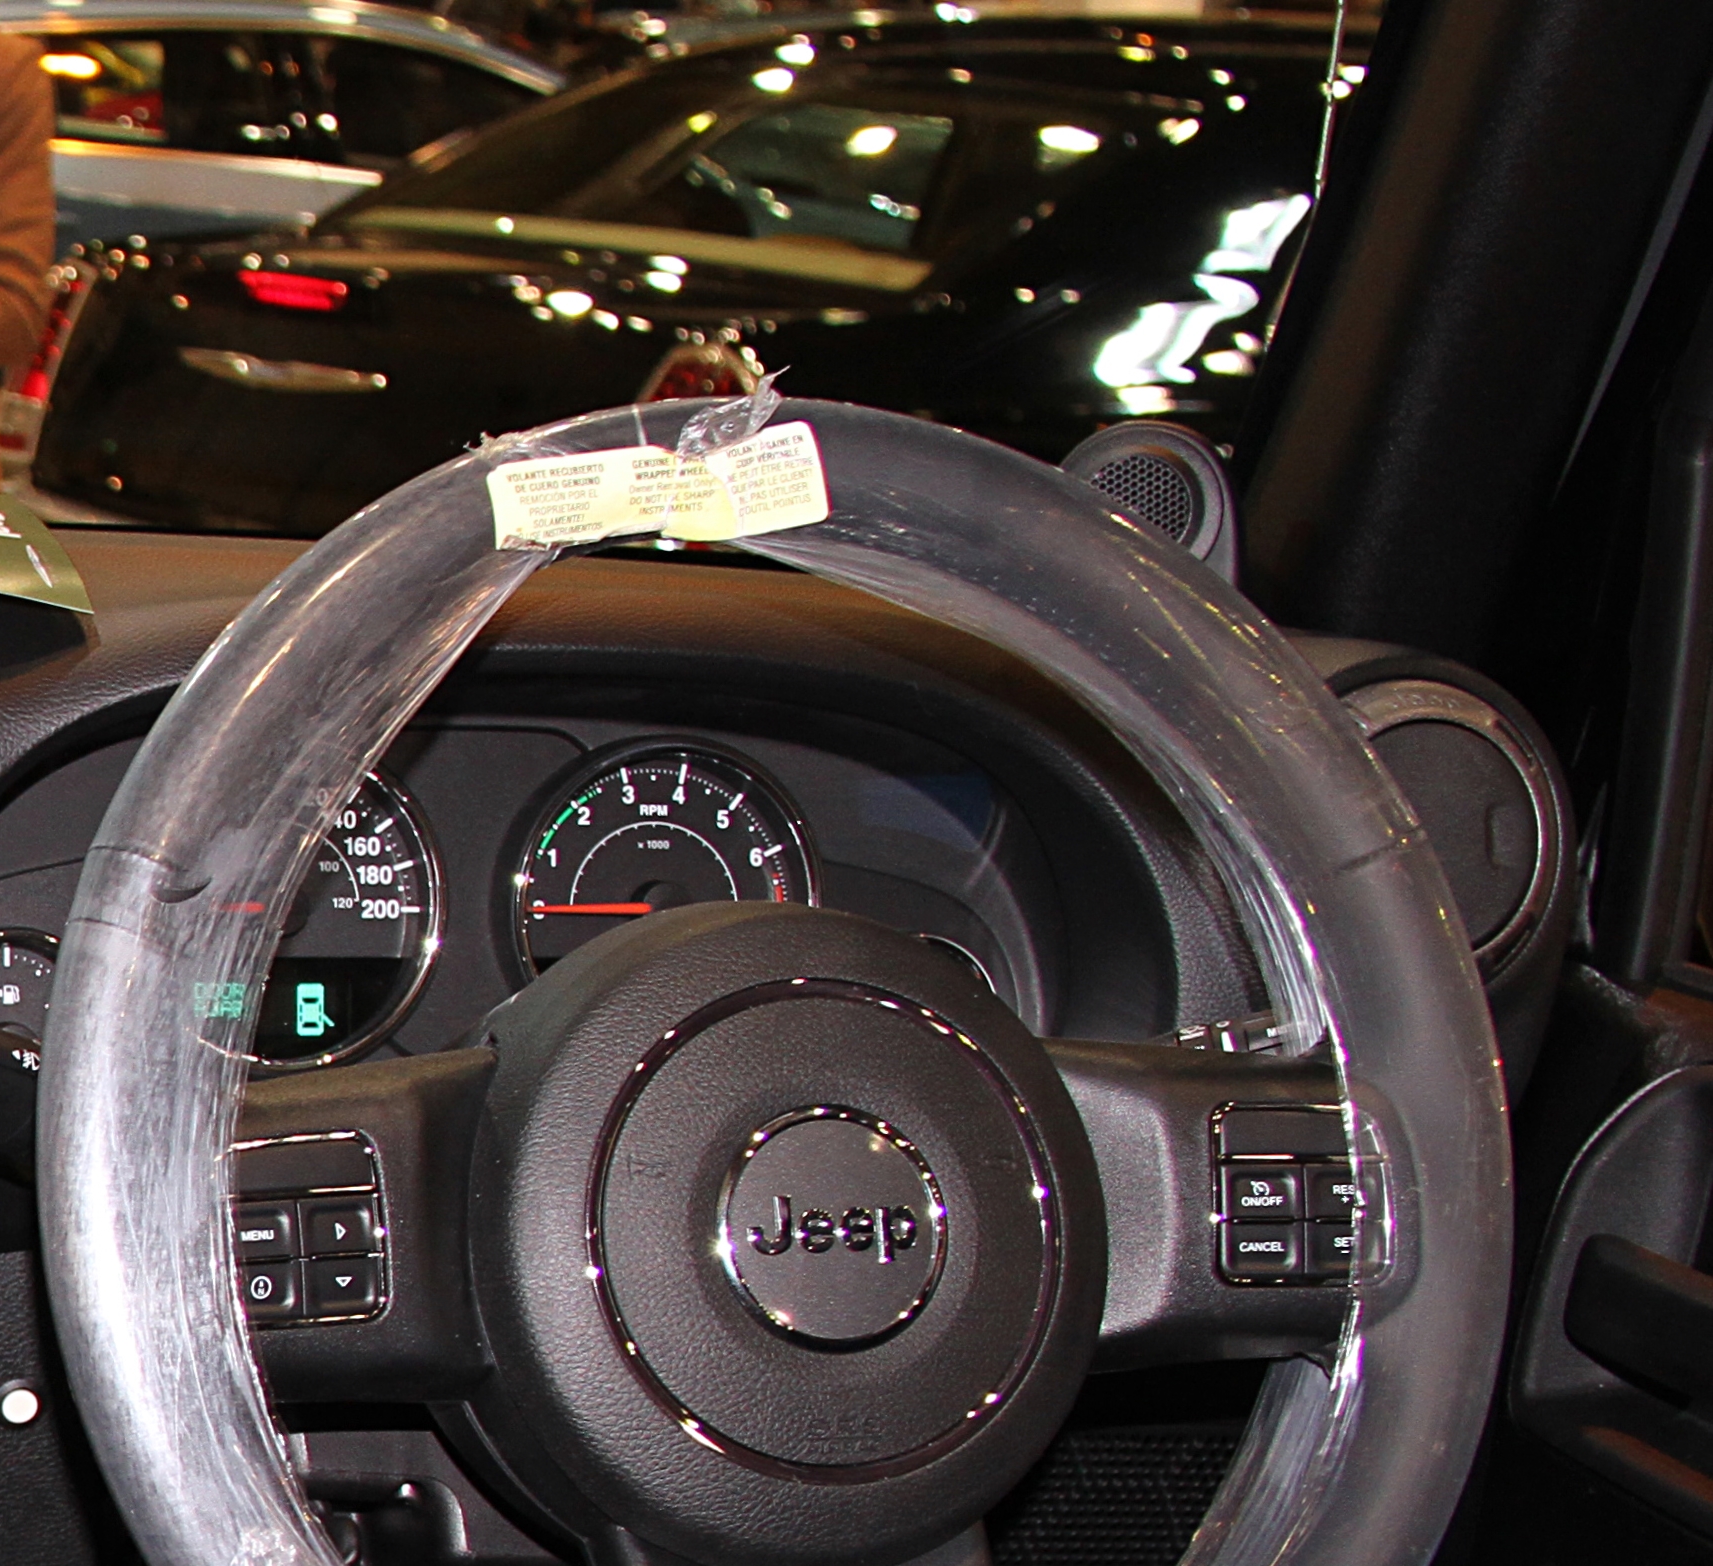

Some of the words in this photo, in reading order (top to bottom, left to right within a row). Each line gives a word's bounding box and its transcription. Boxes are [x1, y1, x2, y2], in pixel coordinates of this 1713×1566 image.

[621, 785, 635, 804] 3
[672, 785, 685, 805] 4
[577, 806, 591, 825] 2
[639, 804, 668, 816] RPM
[716, 809, 729, 829] 5
[344, 837, 381, 857] 160
[647, 840, 670, 849] 1000
[547, 848, 557, 868] 1
[749, 847, 763, 867] 6
[320, 861, 340, 873] 100
[356, 865, 393, 885] 180
[332, 898, 353, 909] 120
[361, 900, 400, 920] 200
[1241, 1196, 1283, 1207] ON/OFF
[240, 1229, 274, 1242] MENU
[746, 1195, 917, 1264] Jeep
[1239, 1242, 1284, 1253] CANCEL
